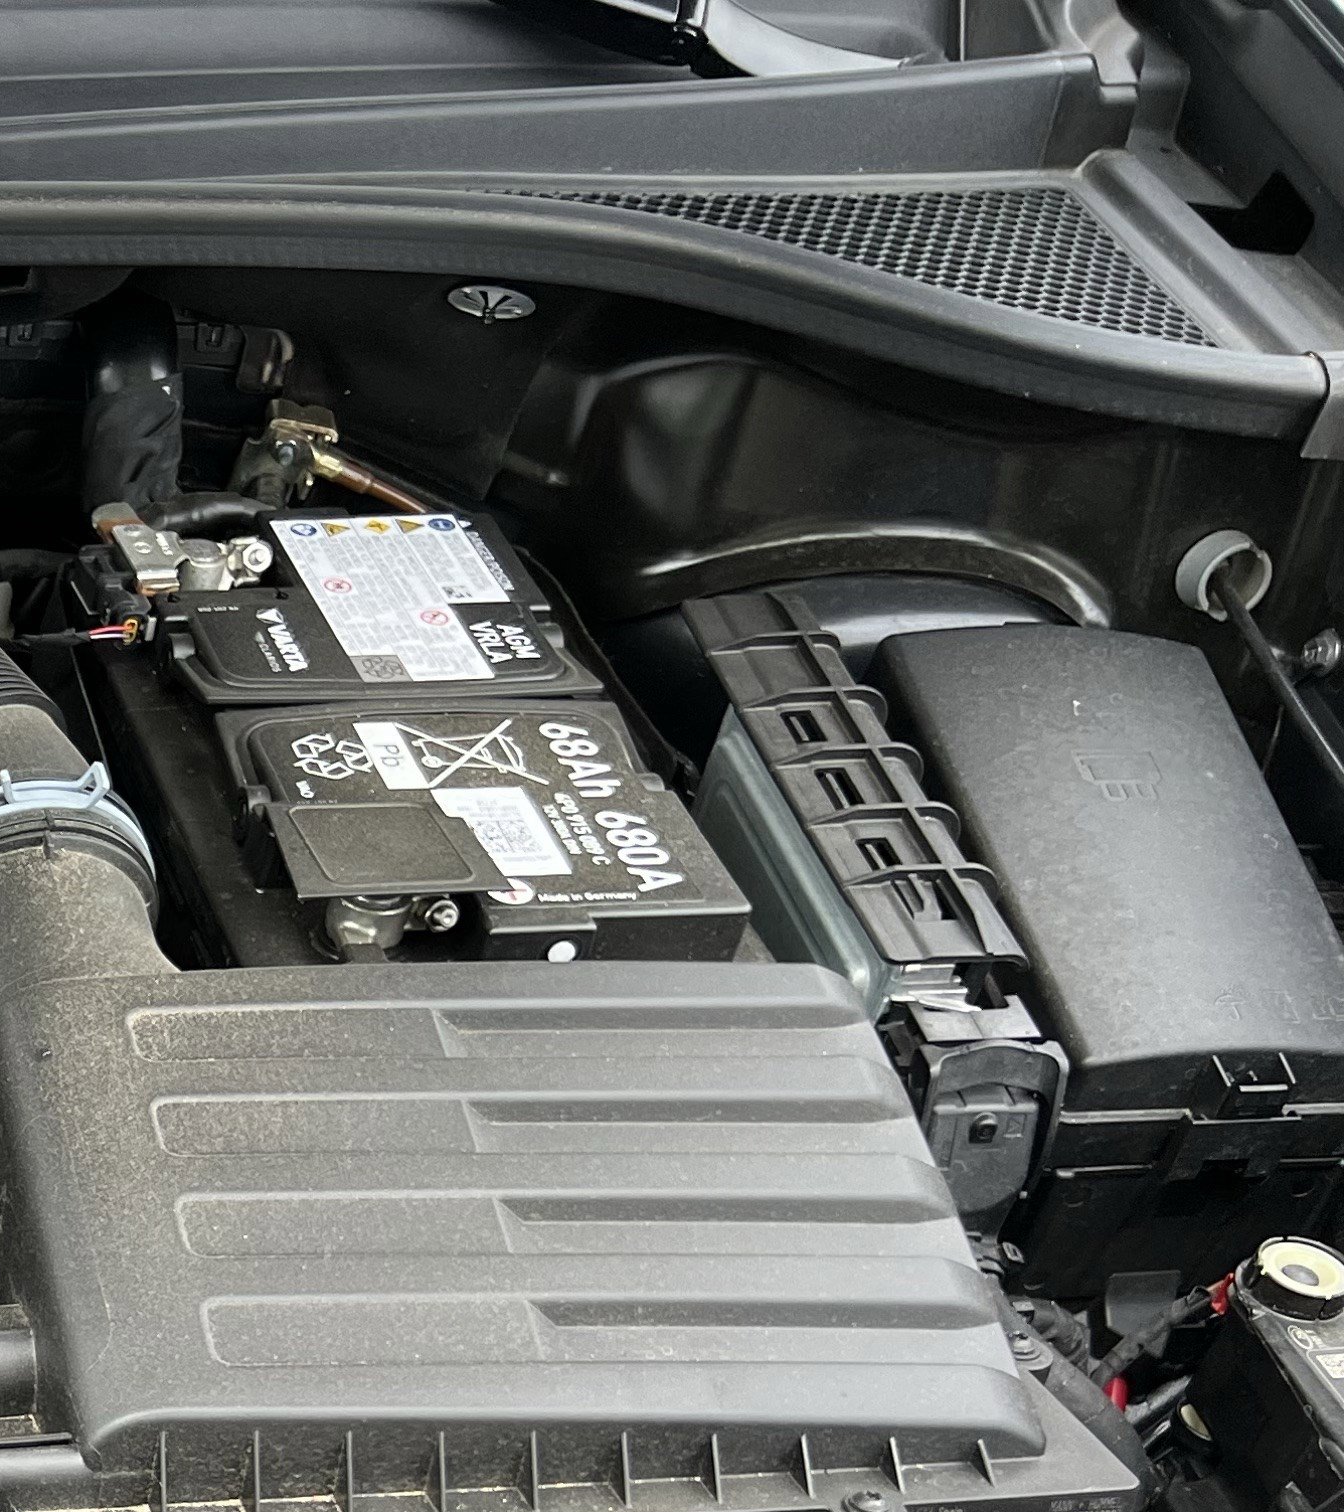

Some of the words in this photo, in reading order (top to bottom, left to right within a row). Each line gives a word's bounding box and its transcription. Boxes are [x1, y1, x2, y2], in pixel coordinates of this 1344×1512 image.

[267, 624, 308, 672] VARTA
[469, 621, 513, 664] VRLA
[496, 624, 541, 659] AGM
[373, 744, 404, 767] Pb
[539, 722, 622, 798] 68Ah
[594, 810, 684, 892] 680A
[538, 893, 570, 903] Made
[570, 893, 583, 901] in
[584, 892, 637, 901] Germany
